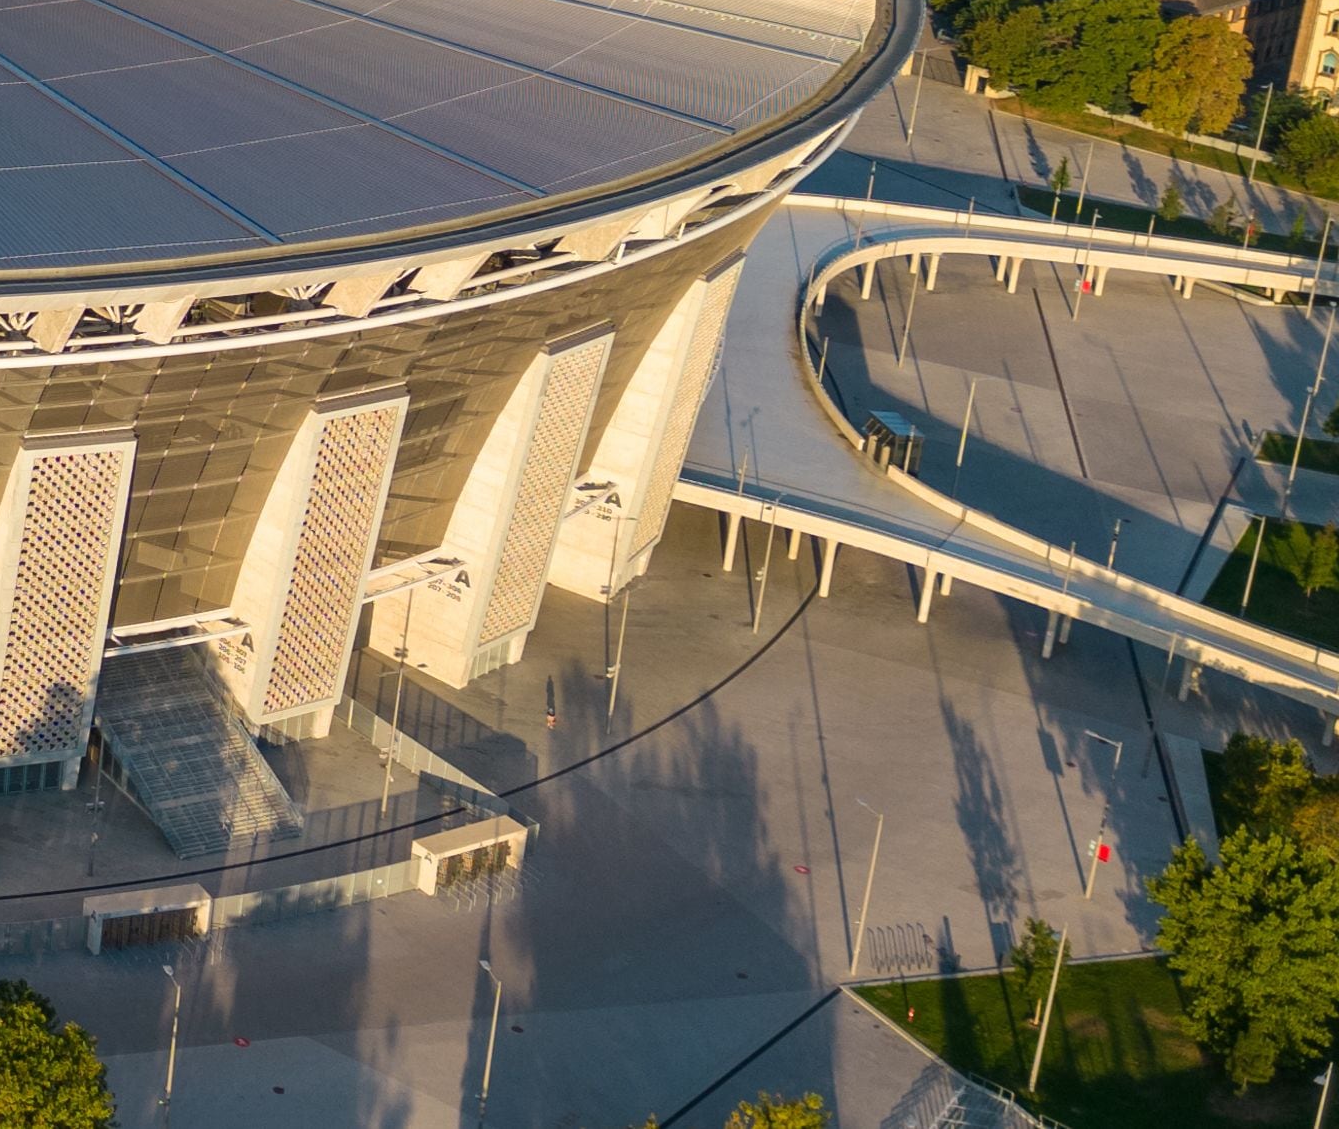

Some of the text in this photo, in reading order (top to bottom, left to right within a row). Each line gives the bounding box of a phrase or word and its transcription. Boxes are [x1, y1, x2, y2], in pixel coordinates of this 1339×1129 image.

[604, 492, 621, 508] A
[454, 570, 471, 588] A
[241, 632, 254, 652] A
